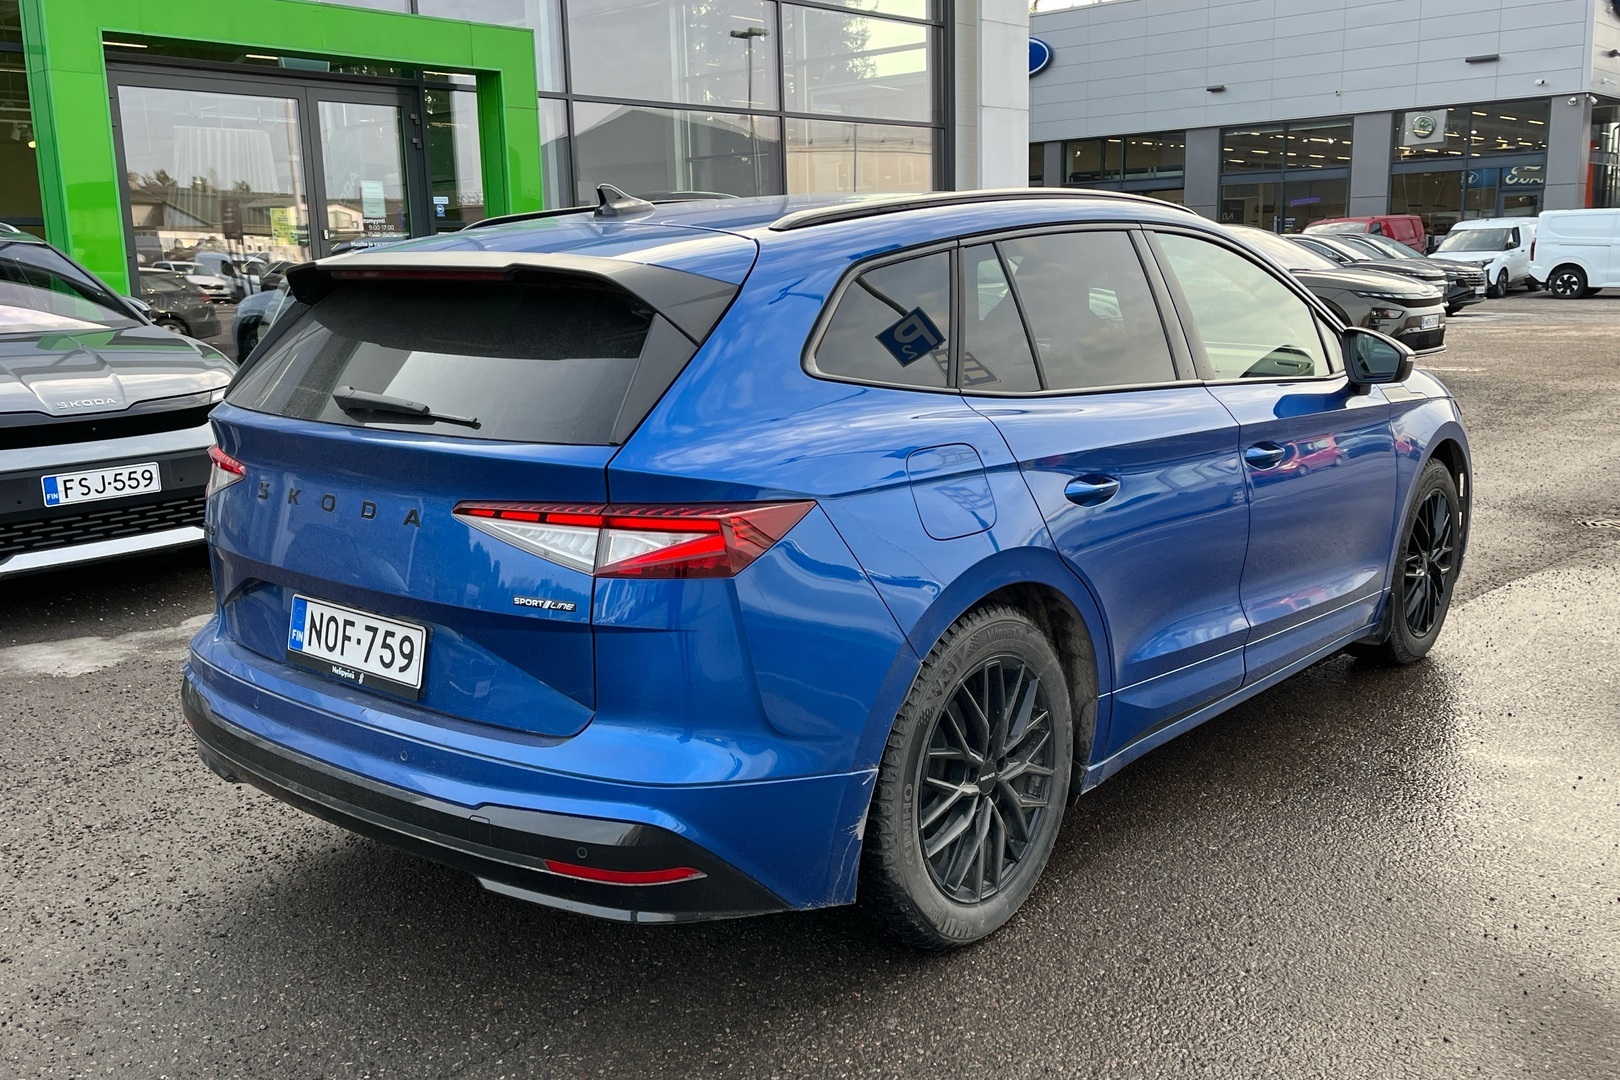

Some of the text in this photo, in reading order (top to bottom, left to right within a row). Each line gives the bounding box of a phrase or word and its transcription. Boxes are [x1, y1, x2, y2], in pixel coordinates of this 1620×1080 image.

[46, 469, 153, 501] FIN FSJ-559
[292, 610, 415, 673] FIN NOF-759
